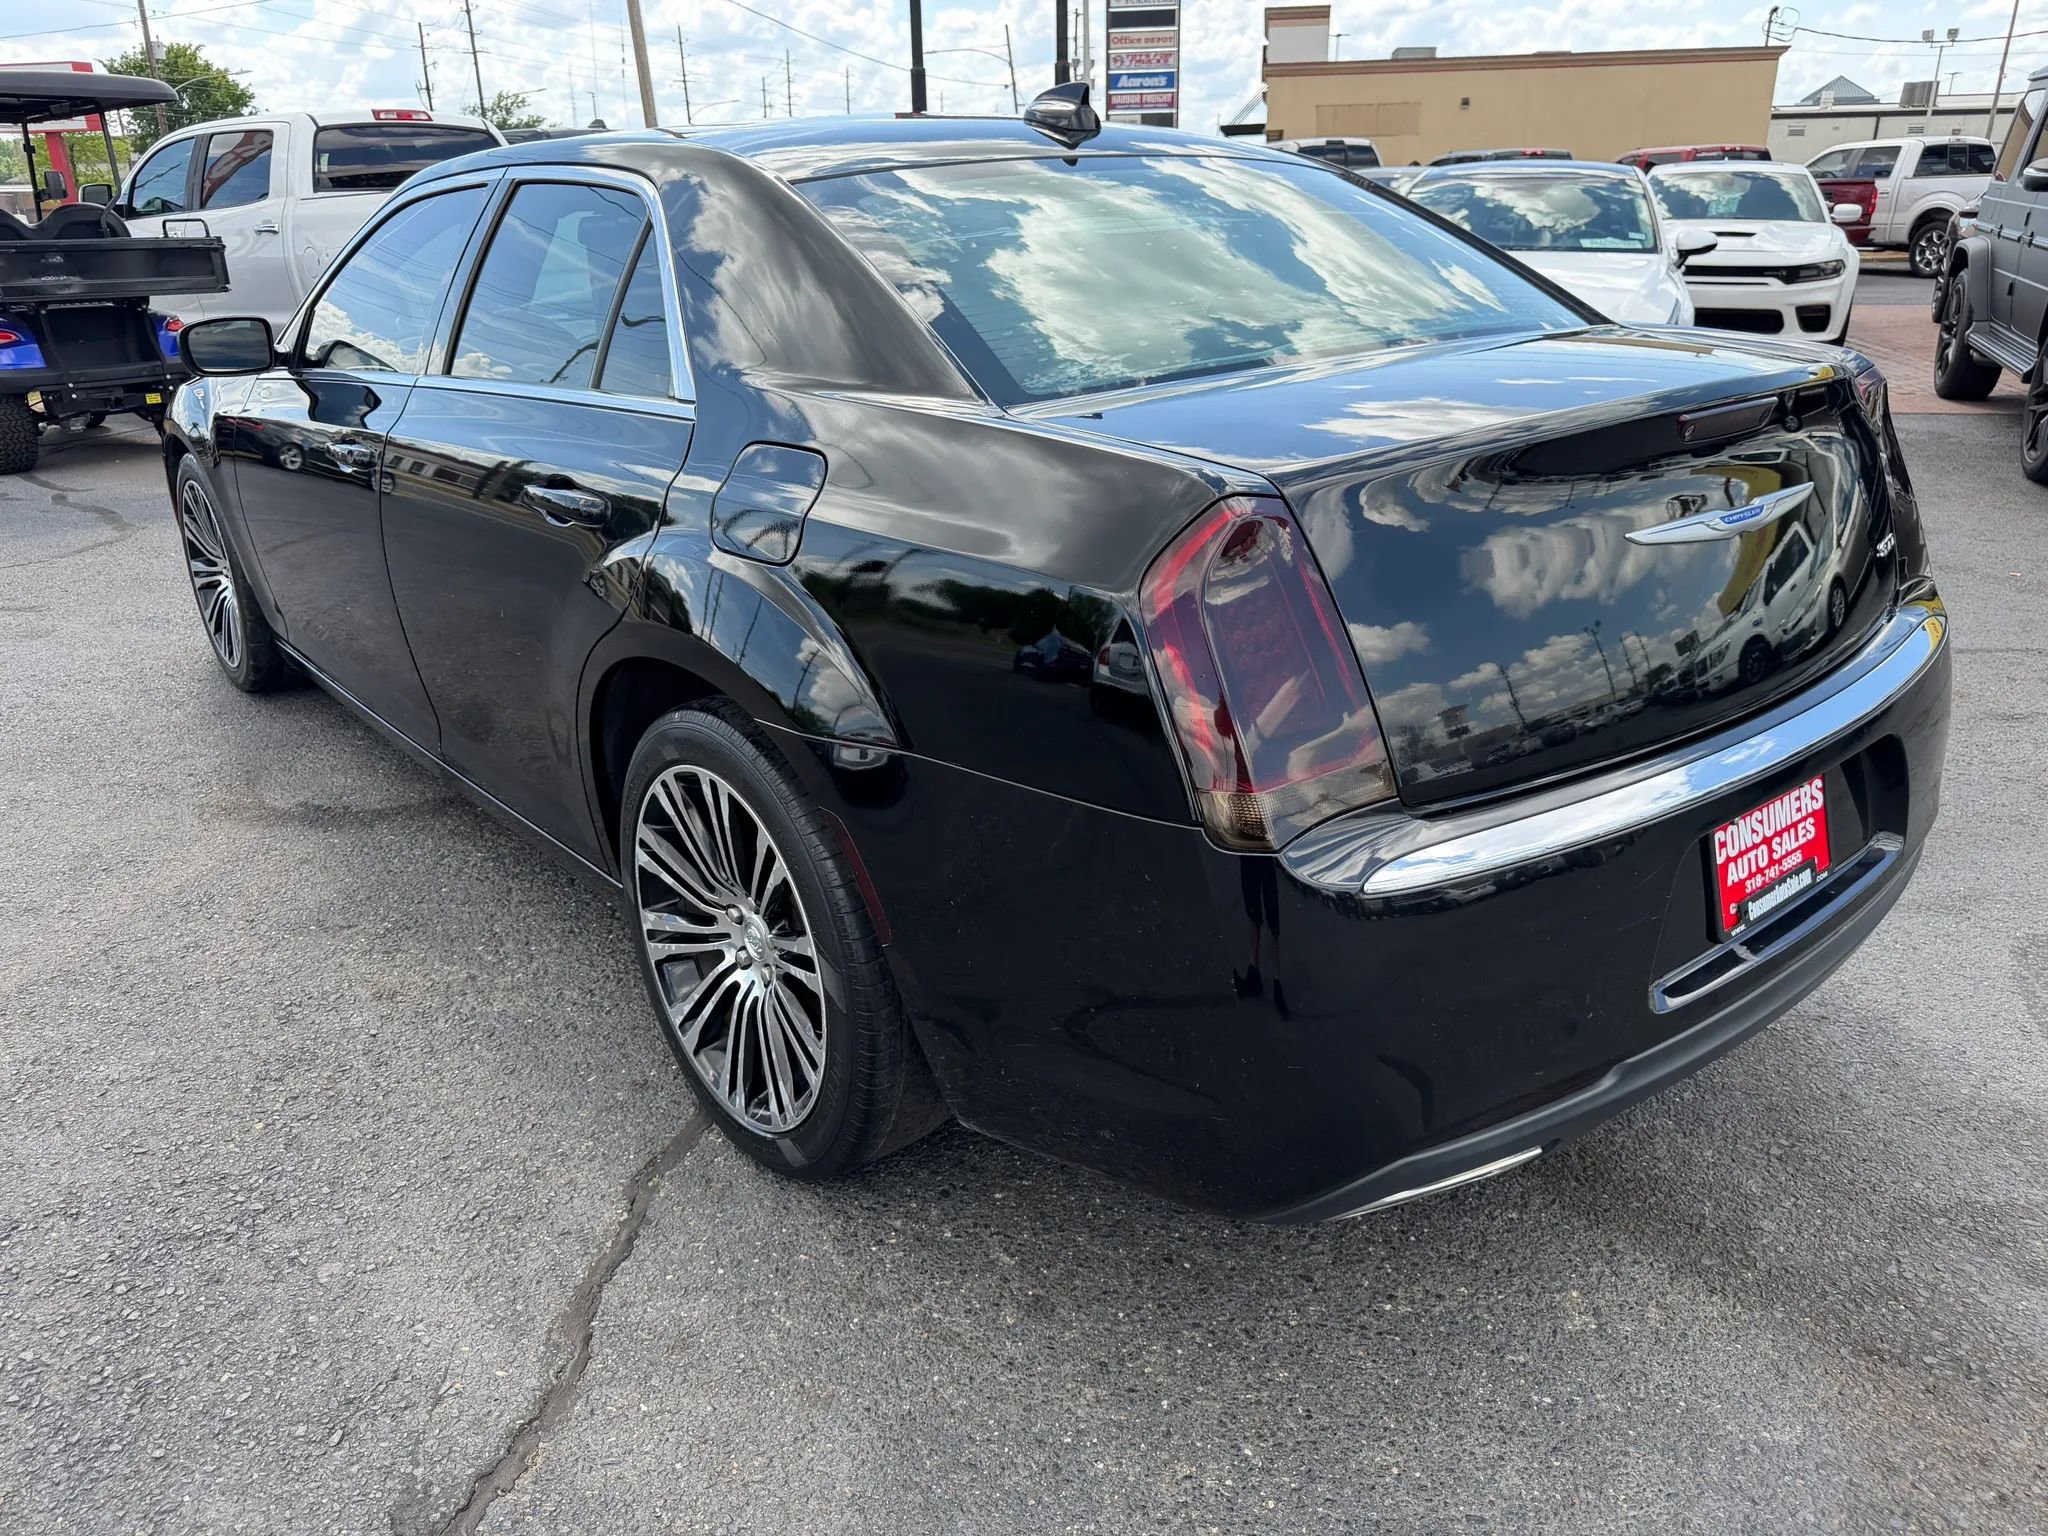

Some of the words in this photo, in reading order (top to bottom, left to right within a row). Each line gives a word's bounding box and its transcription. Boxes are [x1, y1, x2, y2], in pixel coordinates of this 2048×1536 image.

[1112, 36, 1141, 45] Office
[1117, 75, 1168, 88] Aaron's
[1724, 508, 1761, 523] CHRYSLER
[1714, 778, 1824, 865] CONSUMERS
[1727, 844, 1769, 887] AUTO
[1771, 816, 1816, 860] SALES
[1745, 849, 1803, 893] 318-741-5555
